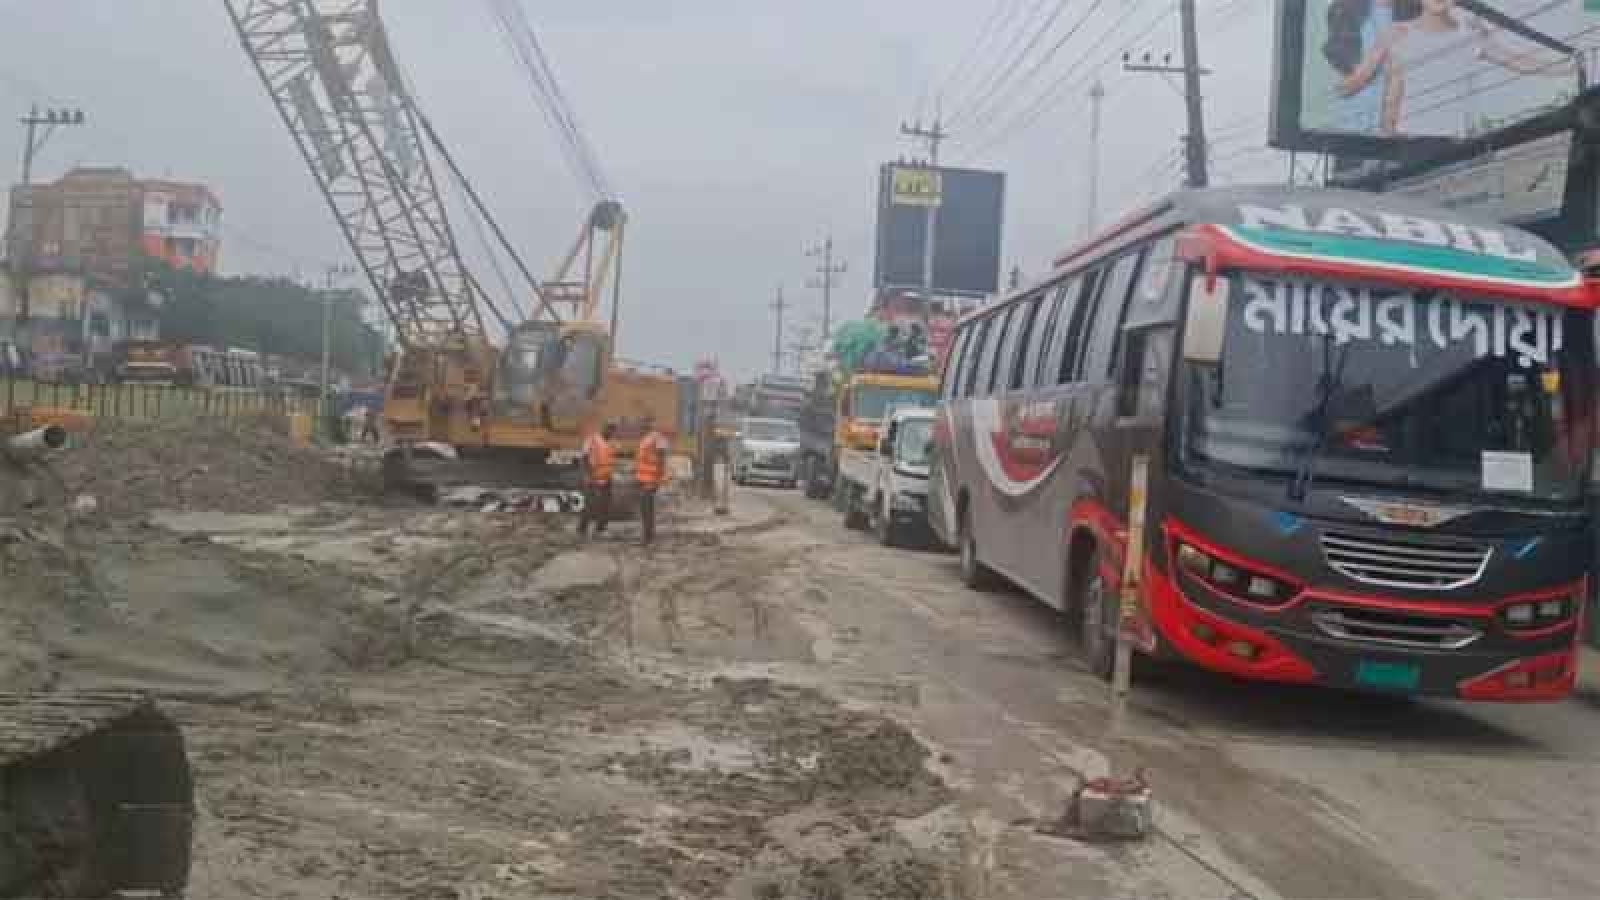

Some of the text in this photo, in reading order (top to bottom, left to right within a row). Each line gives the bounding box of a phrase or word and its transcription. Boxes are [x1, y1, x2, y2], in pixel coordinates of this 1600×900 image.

[1237, 205, 1537, 261] NABIL
[1243, 281, 1564, 368] মায়ের দোয়া
